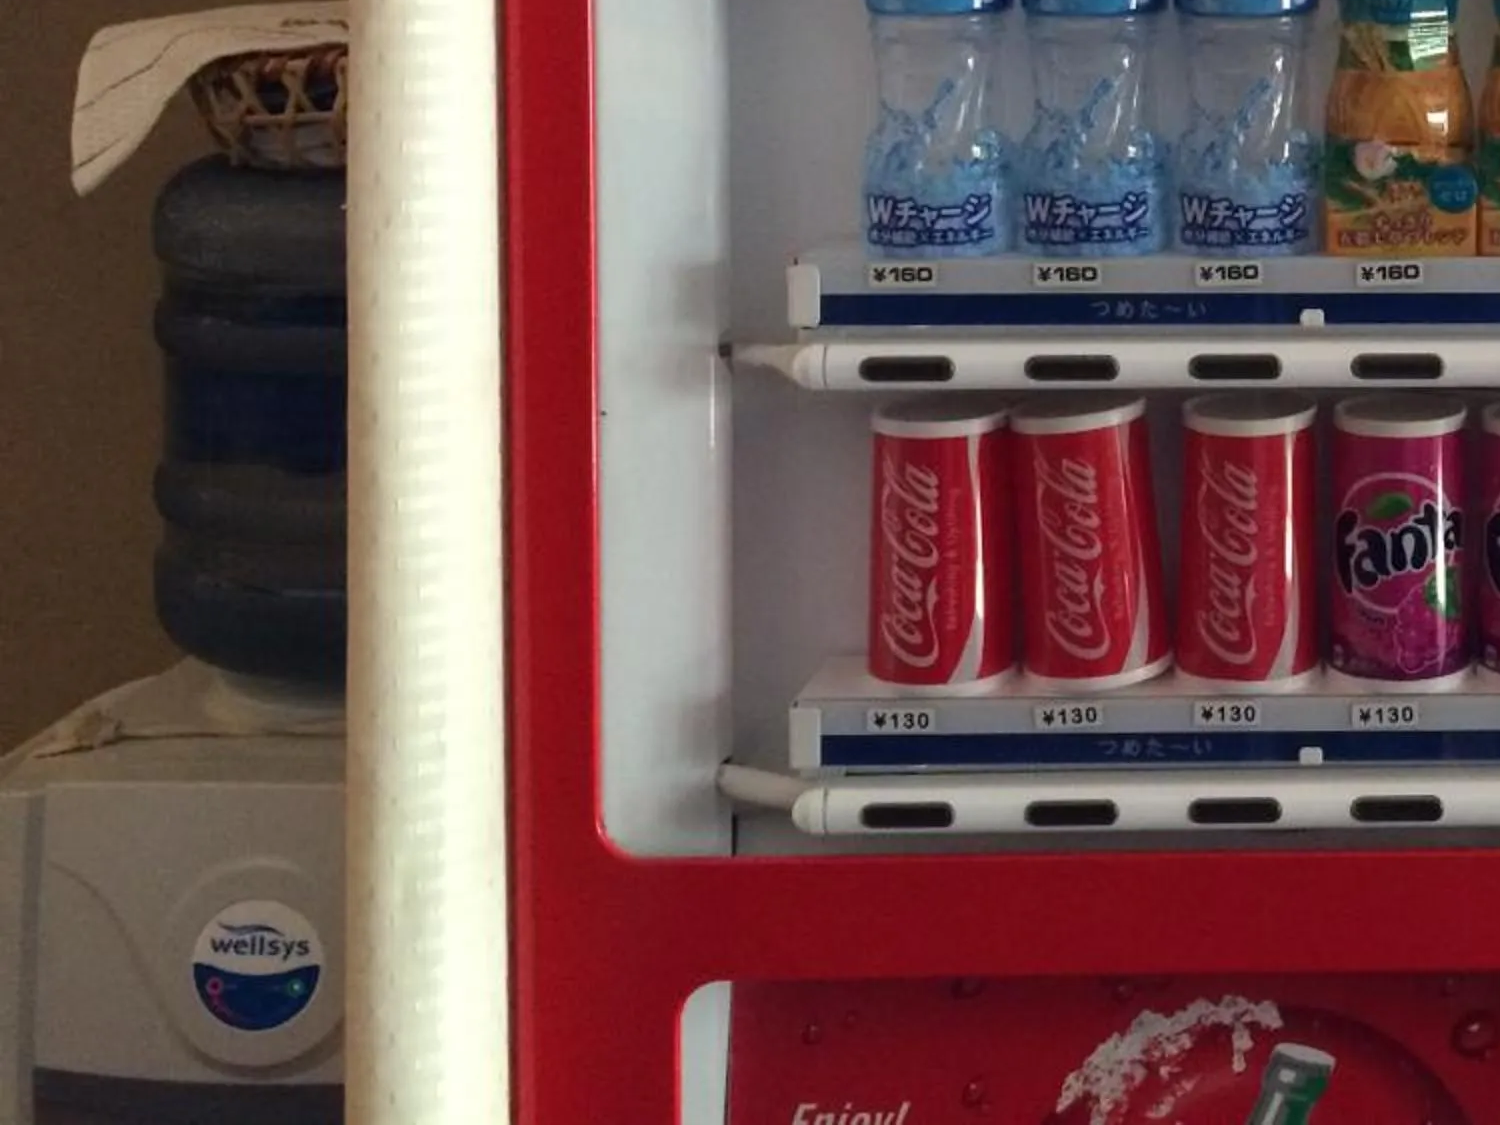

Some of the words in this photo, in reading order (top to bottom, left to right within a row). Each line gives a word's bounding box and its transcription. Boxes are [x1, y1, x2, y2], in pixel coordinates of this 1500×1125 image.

[868, 193, 991, 226] Wチャージ
[1026, 192, 1149, 225] Wチャージ
[1181, 193, 1305, 225] Wチャージ
[873, 266, 933, 283] ¥160
[1038, 266, 1098, 282] ¥160
[1200, 264, 1259, 281] ¥160
[1361, 264, 1420, 281] ¥160
[1334, 502, 1463, 595] Fanta
[874, 712, 929, 730] ¥130
[1042, 706, 1098, 726] ¥130
[1201, 705, 1256, 723] ¥130
[1359, 706, 1414, 724] ¥130
[210, 936, 310, 960] wellsys
